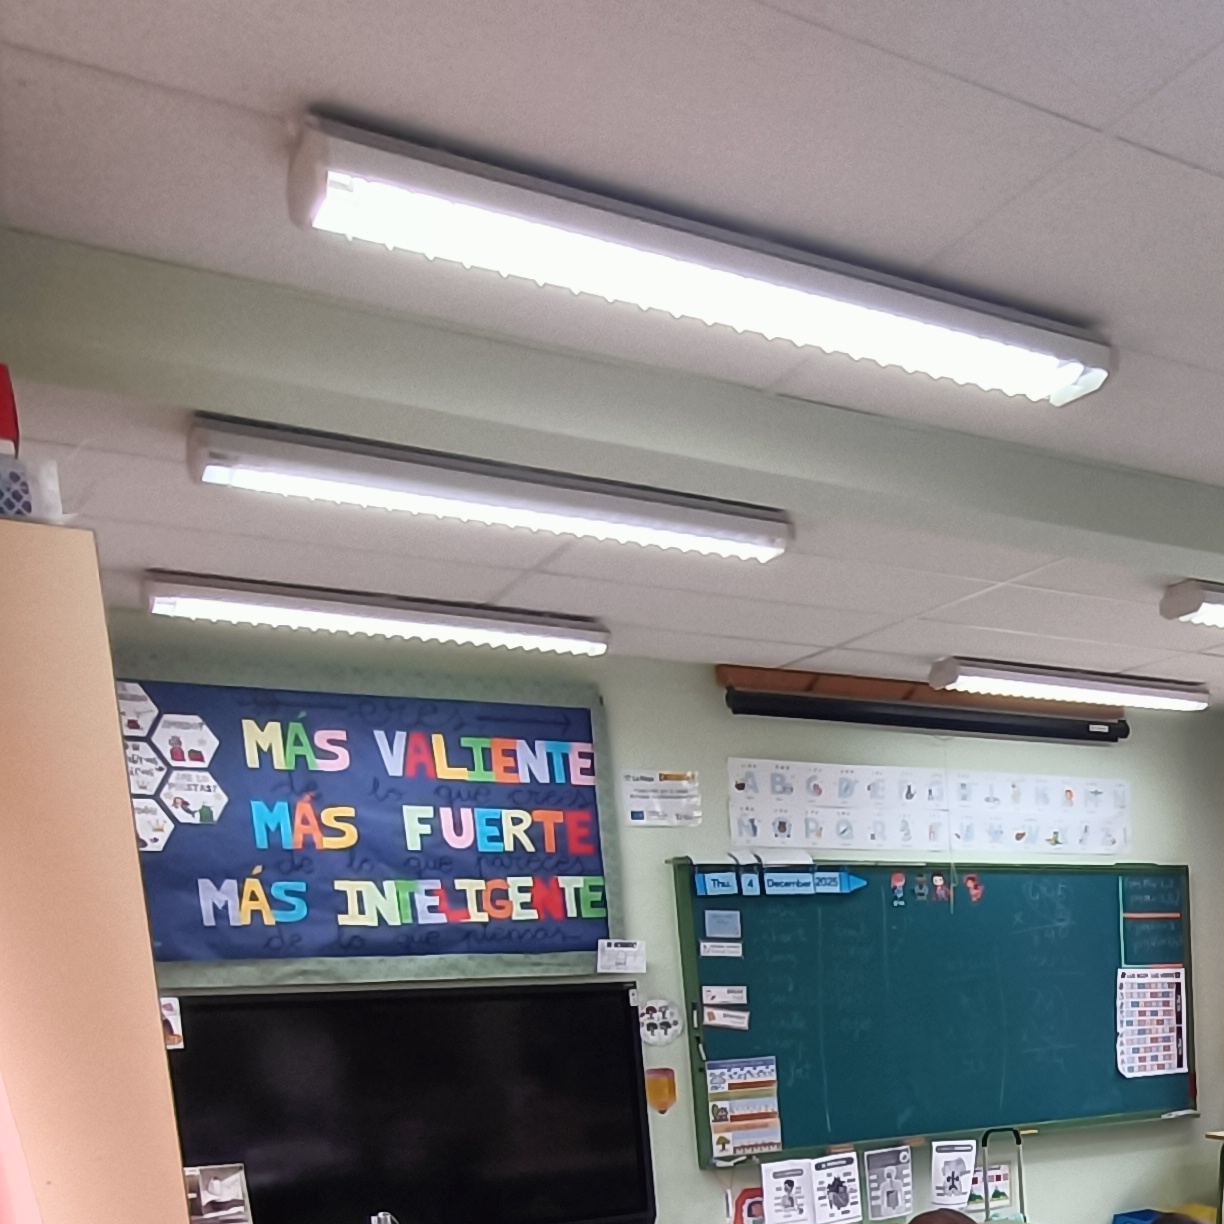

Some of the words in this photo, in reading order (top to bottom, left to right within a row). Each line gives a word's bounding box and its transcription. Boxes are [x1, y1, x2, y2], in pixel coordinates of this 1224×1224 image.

[241, 711, 350, 772] MÁS
[373, 729, 596, 786] VALIENTE
[249, 790, 359, 851] MÁS
[402, 804, 595, 854] FUERTE
[197, 865, 309, 927] MÁS
[333, 876, 607, 927] INTELIGENTE
[747, 878, 755, 888] 4
[767, 878, 812, 888] December
[815, 876, 839, 887] 2025
